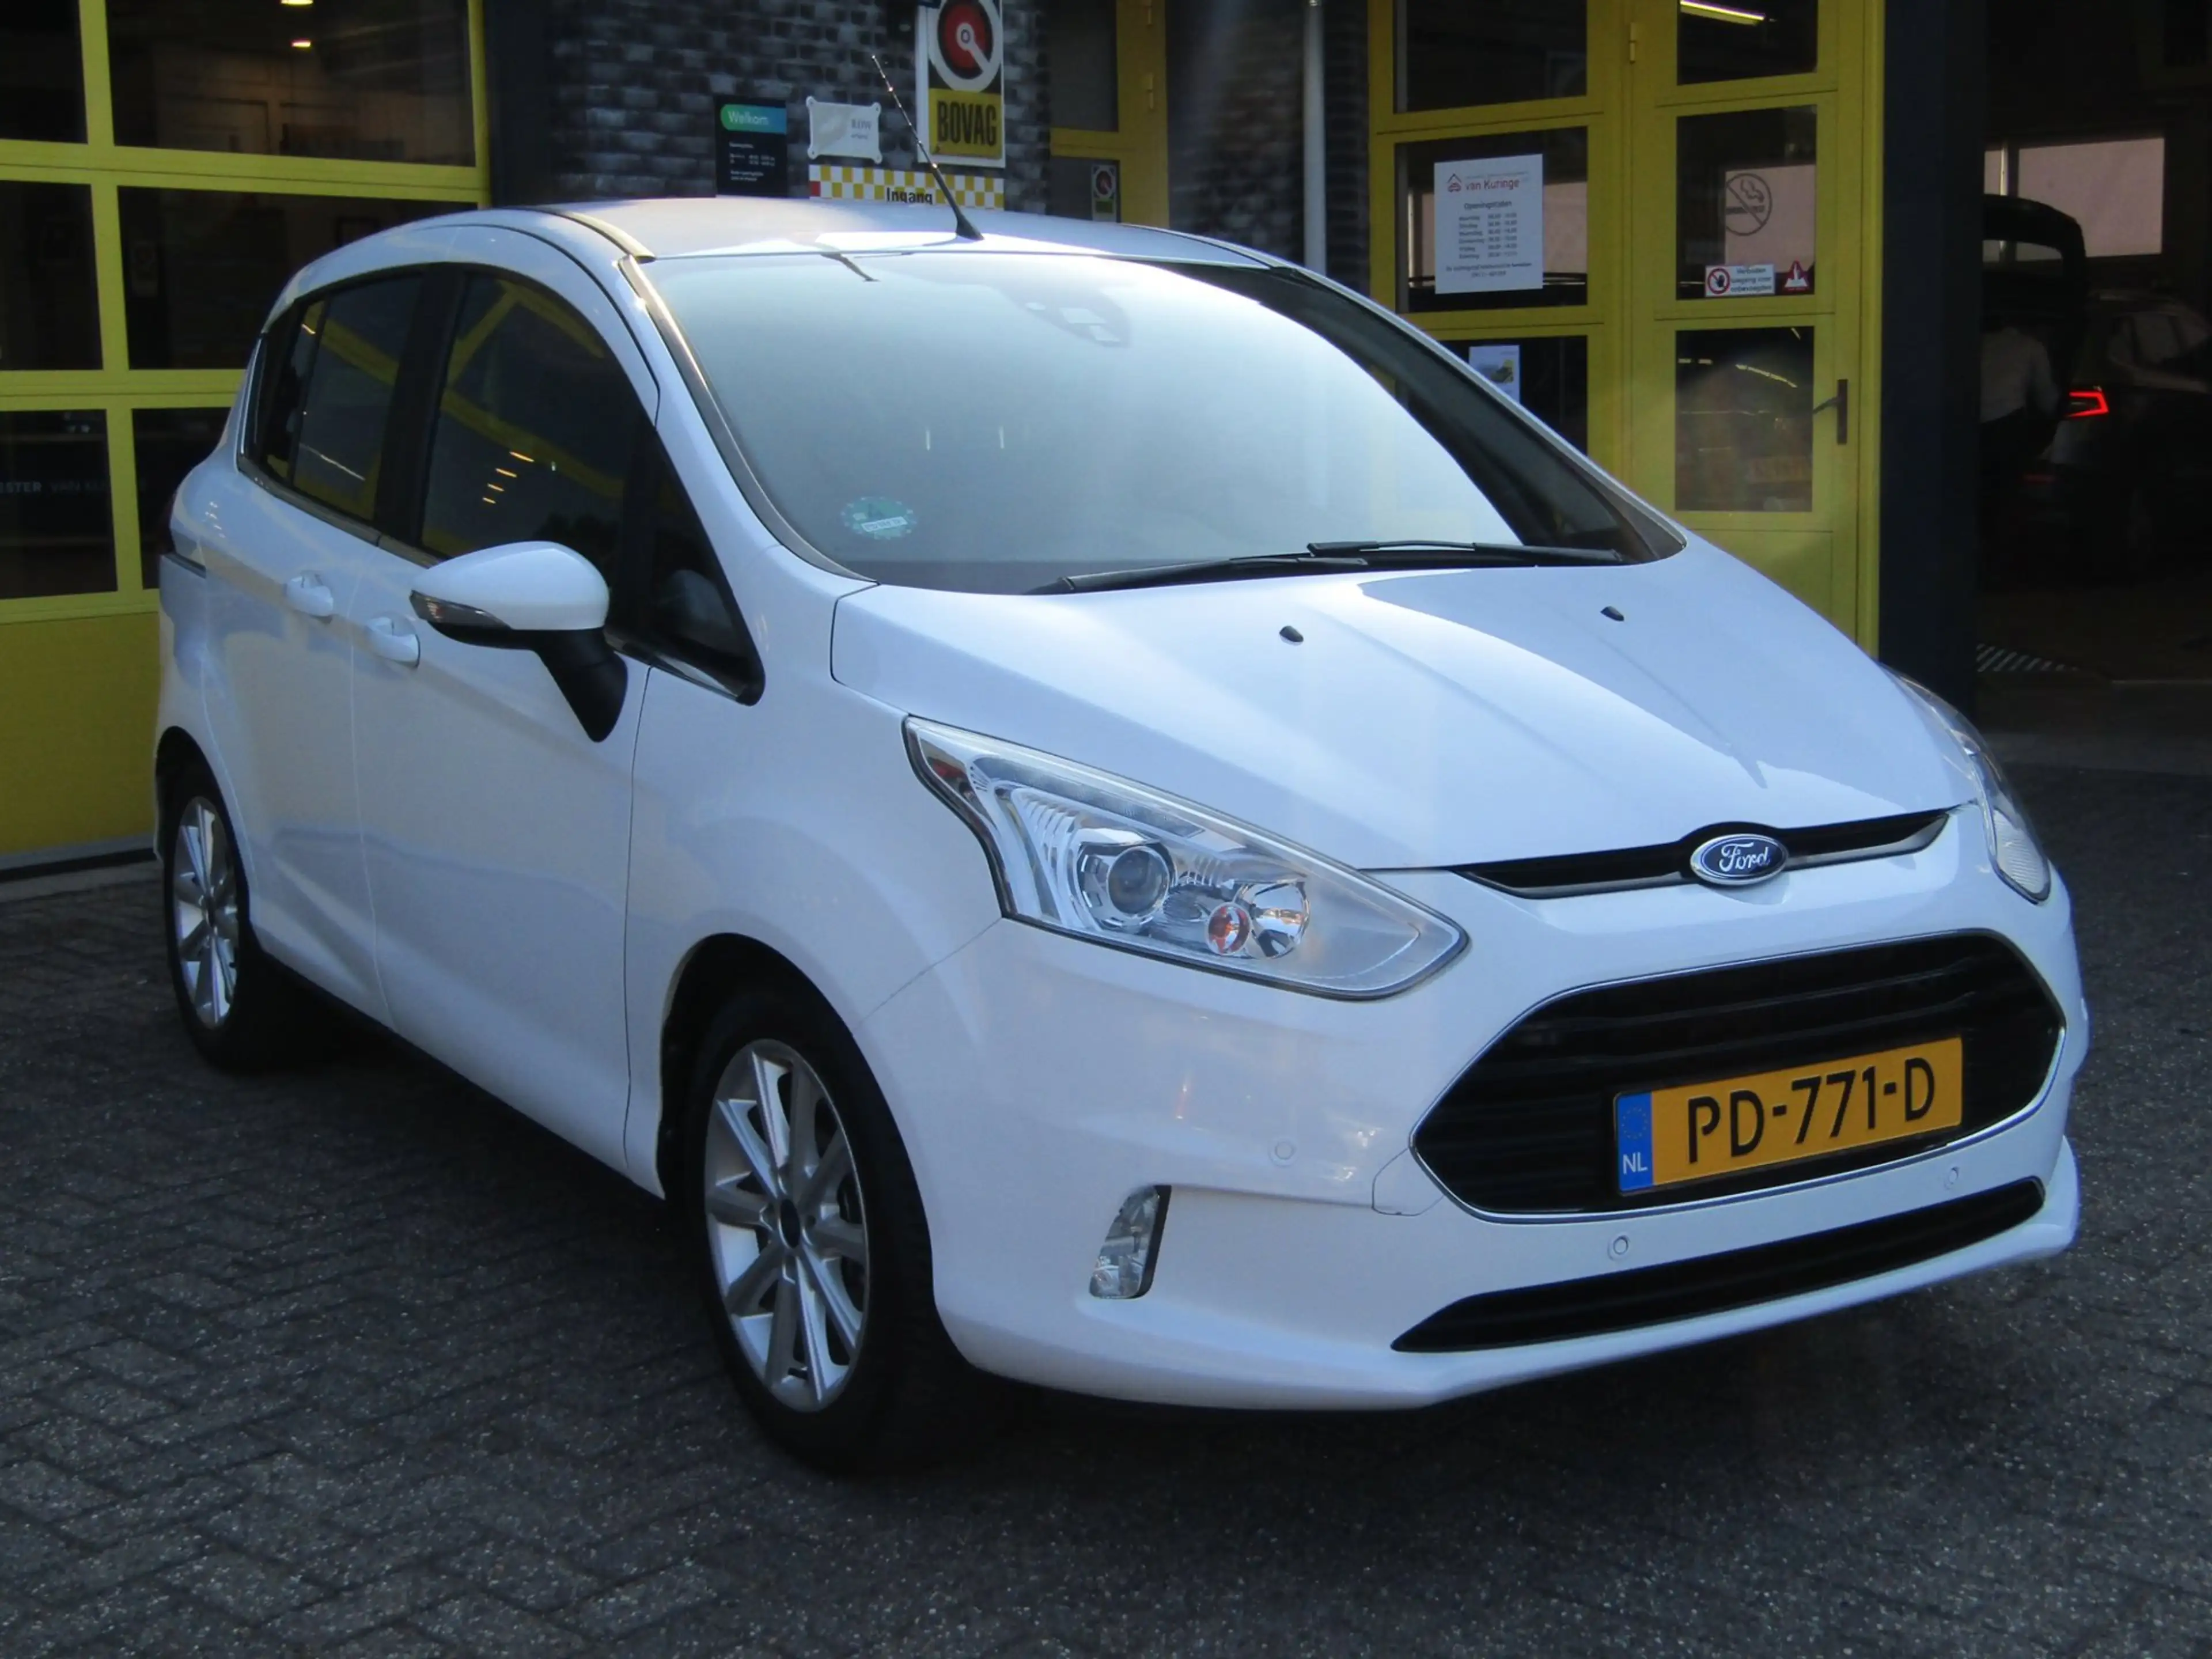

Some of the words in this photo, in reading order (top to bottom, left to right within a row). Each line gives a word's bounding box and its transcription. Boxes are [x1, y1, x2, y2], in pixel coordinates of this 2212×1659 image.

[728, 111, 768, 125] Welkom
[937, 101, 997, 146] BOVAG
[887, 188, 933, 204] Ingang
[1719, 842, 1770, 872] Ford
[1687, 1057, 1936, 1164] PD-771-D
[1623, 1153, 1647, 1174] NL
